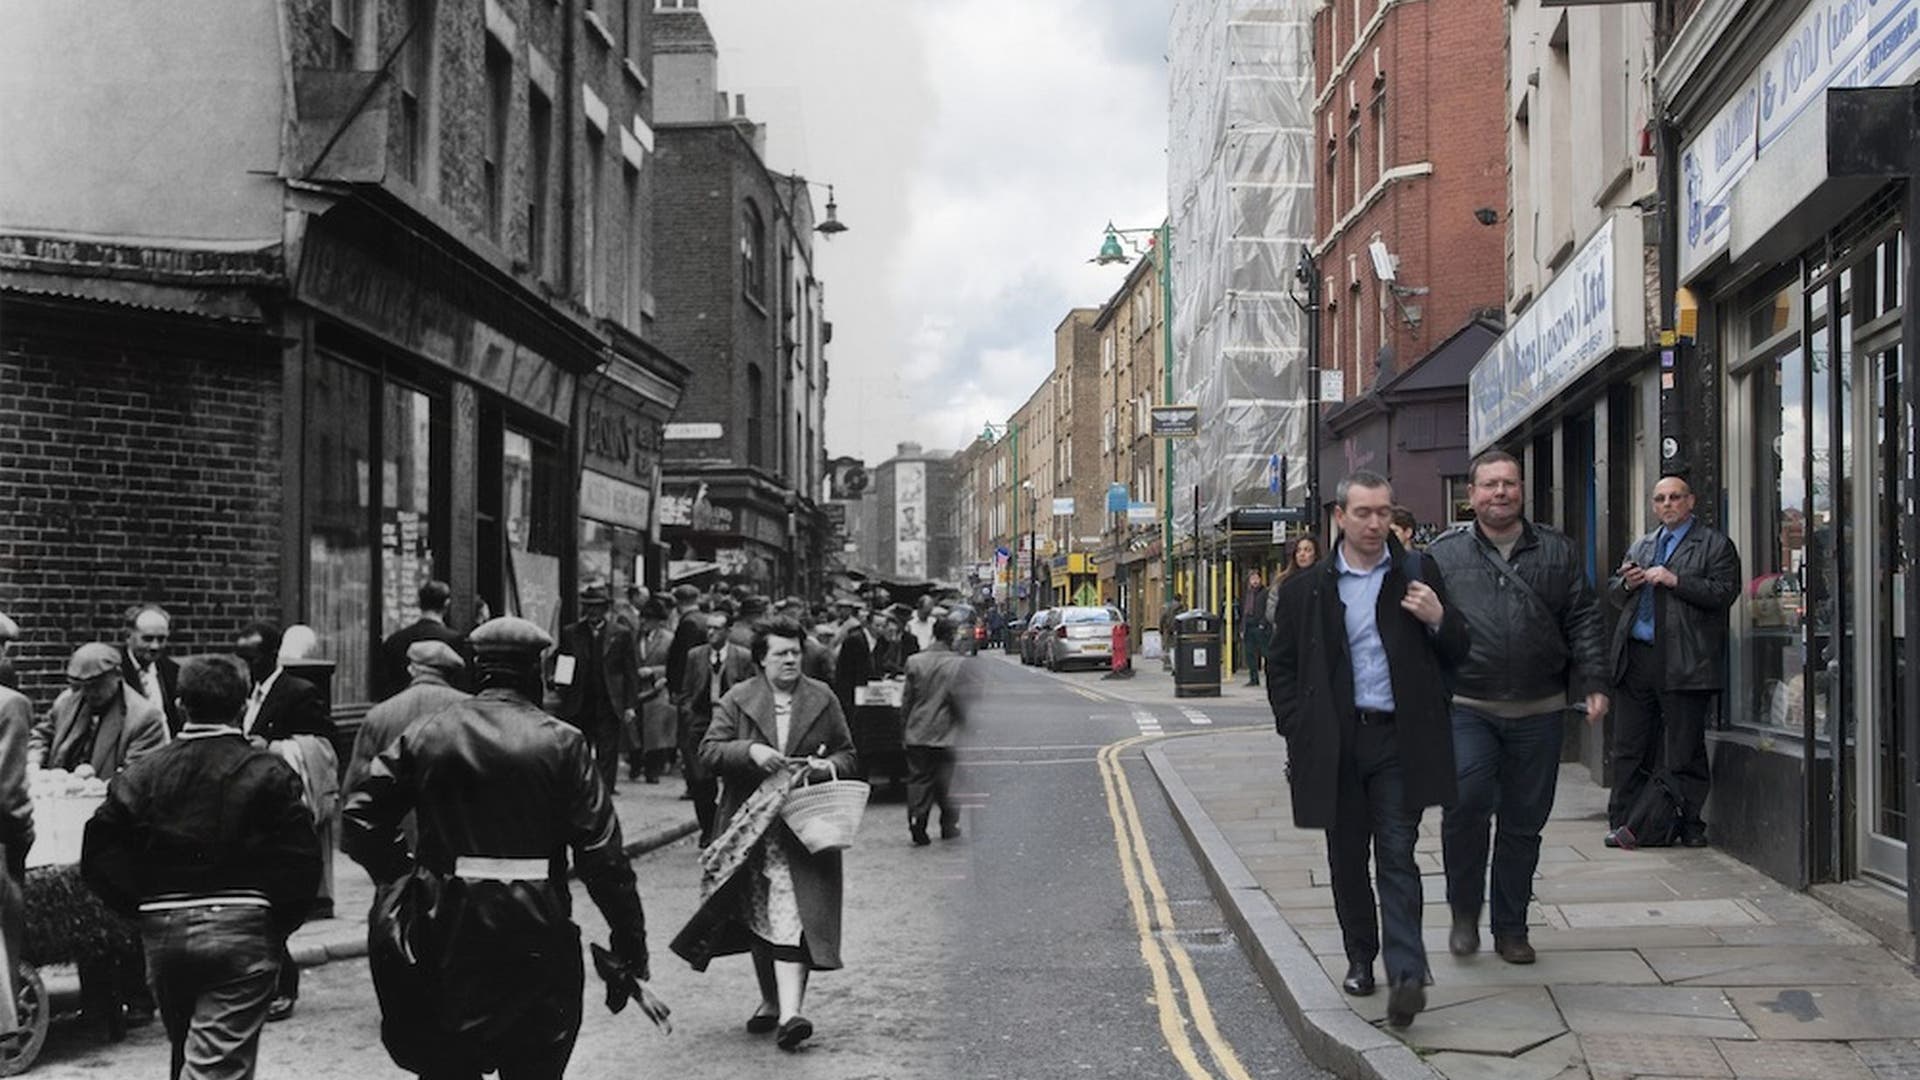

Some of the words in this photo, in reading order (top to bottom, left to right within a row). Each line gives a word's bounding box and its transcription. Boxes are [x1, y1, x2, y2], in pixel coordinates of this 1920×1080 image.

[1762, 70, 1777, 122] &
[1780, 12, 1822, 106] SONS
[1583, 254, 1607, 327] Ltd
